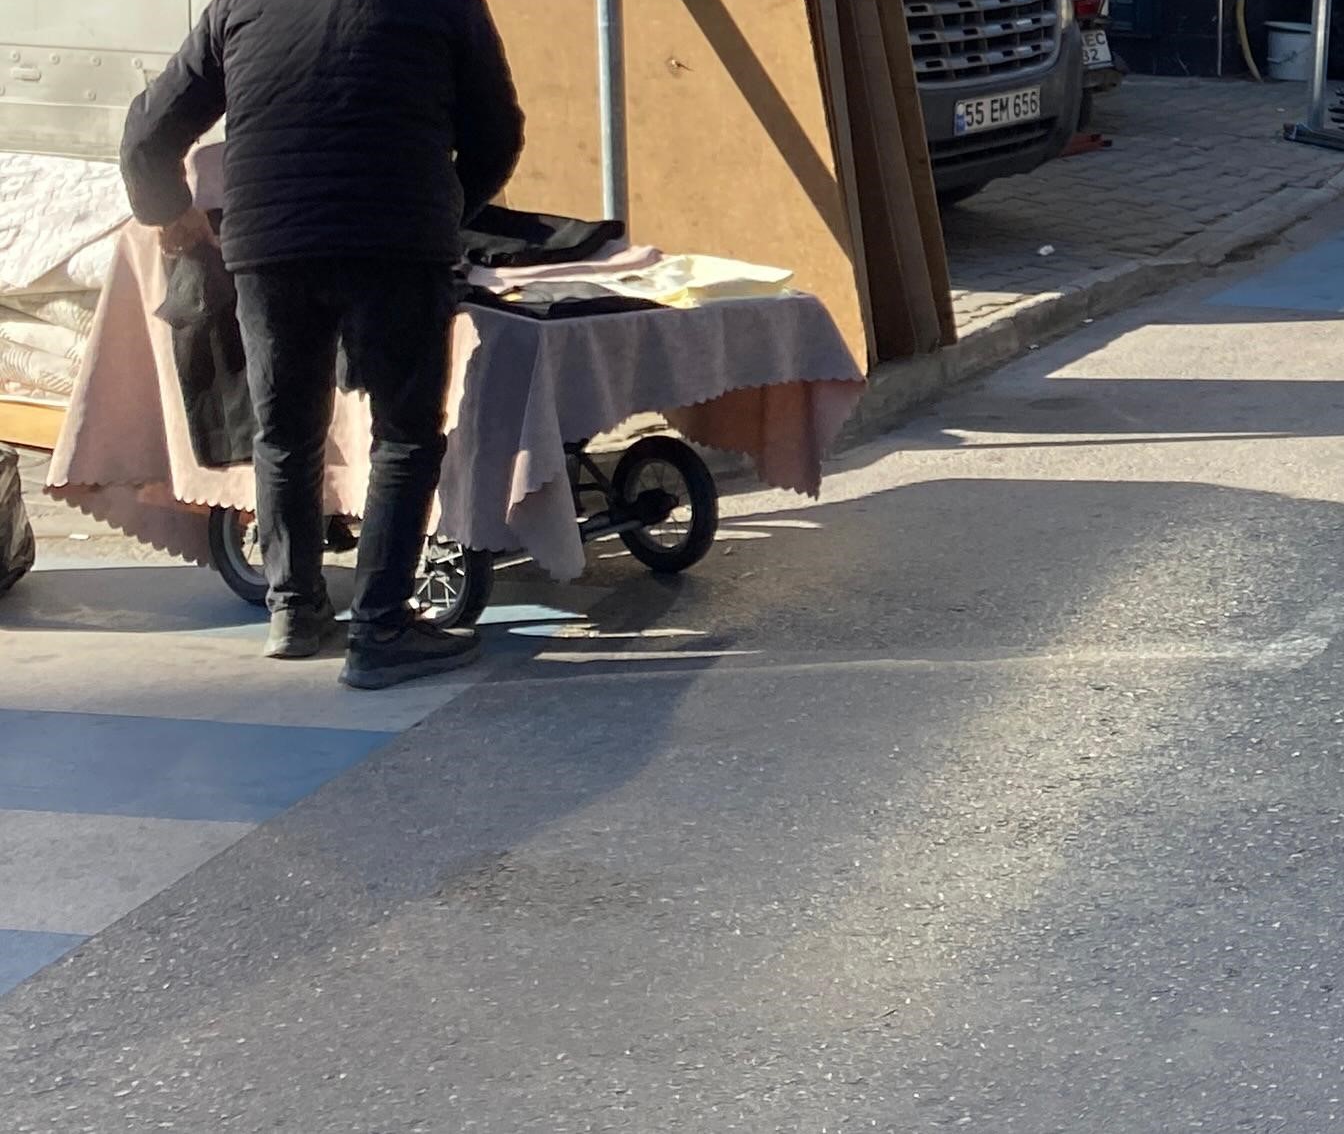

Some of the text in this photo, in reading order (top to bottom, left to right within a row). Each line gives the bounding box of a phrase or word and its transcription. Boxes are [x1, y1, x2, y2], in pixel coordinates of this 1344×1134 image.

[965, 91, 1039, 126] 55 EM 656
